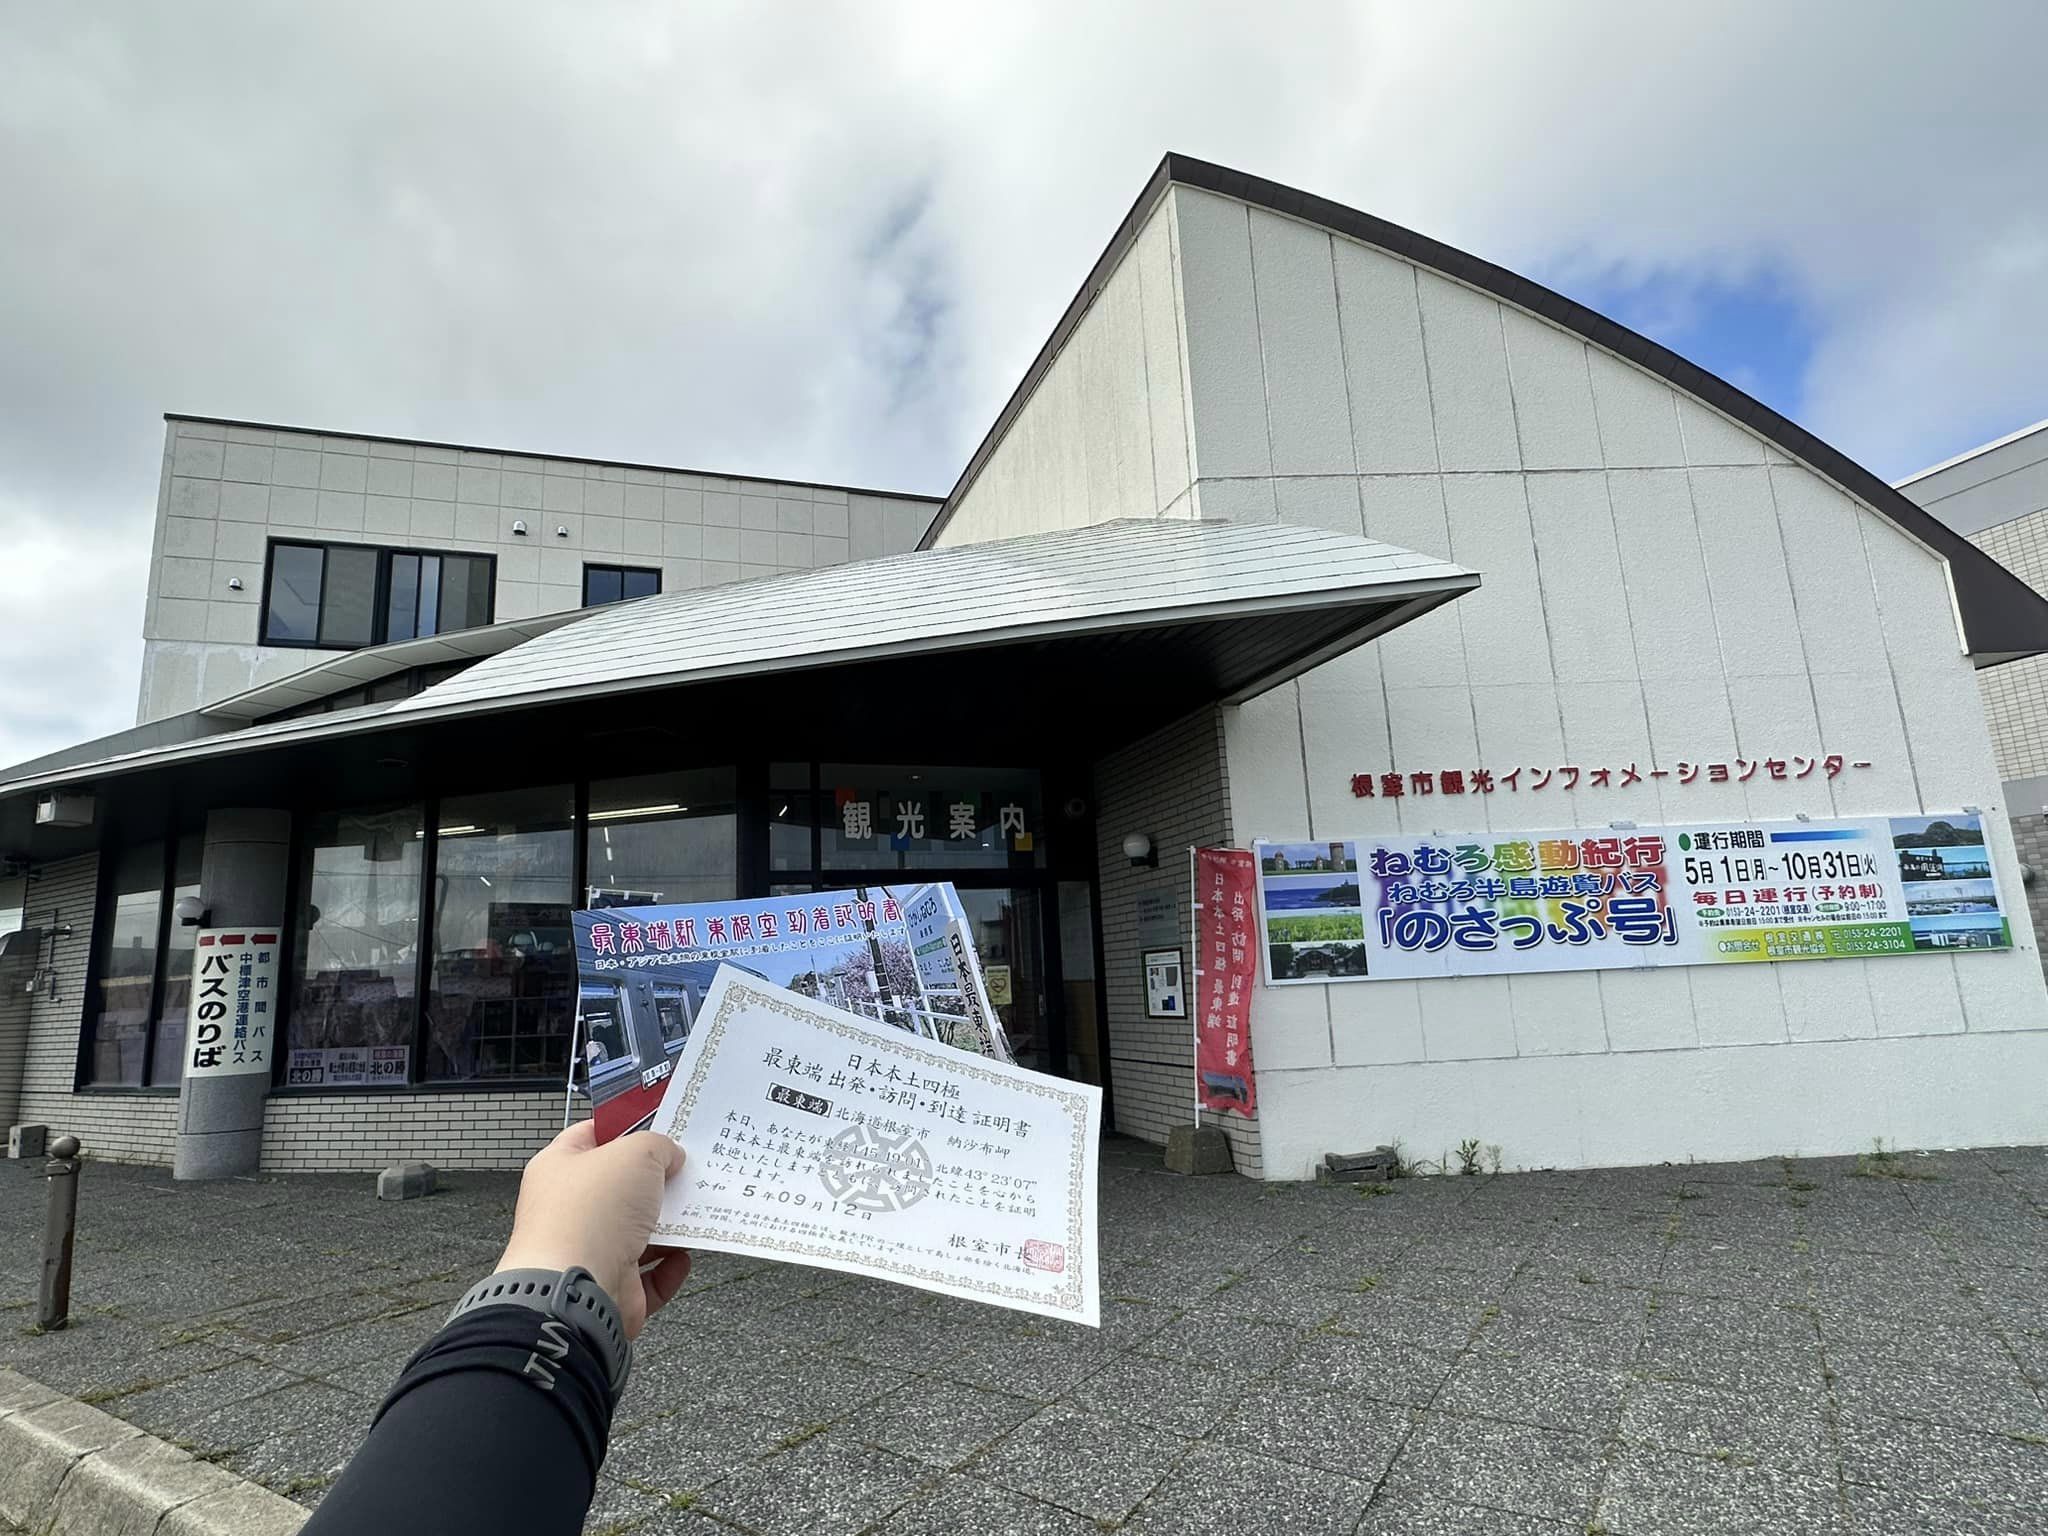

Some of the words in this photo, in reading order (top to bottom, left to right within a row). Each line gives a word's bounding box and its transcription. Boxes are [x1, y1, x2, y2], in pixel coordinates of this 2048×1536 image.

[1351, 755, 1872, 798] 根室市観光インフォメーションセンター
[842, 800, 1025, 840] 観光案内
[1694, 831, 1765, 850] 運行期間
[1370, 835, 1666, 877] ねむろ感動紀行
[1388, 871, 1662, 903] ねむろ半島遊覧バス
[1693, 884, 1884, 905] 毎日運行(予約制)
[591, 918, 698, 955] 最東端駅
[706, 910, 779, 945] 東根室
[786, 898, 903, 935] 到着証明書
[1378, 898, 1679, 952] 「のさっぷ号」
[1843, 927, 1903, 938] 0153-24-2201
[1845, 939, 1906, 951] 0153-24-3104
[193, 953, 234, 1068] バスのりば
[251, 951, 271, 1063] 都市間バス
[762, 1046, 823, 1082] 最東端
[973, 1111, 1032, 1138] 証明書
[848, 1054, 960, 1100] 日本本土四極
[774, 1087, 824, 1115] 最東端
[835, 1107, 931, 1140] 北海道根室市
[946, 1136, 1010, 1159] 納沙布岬
[706, 1160, 785, 1184] いたします。
